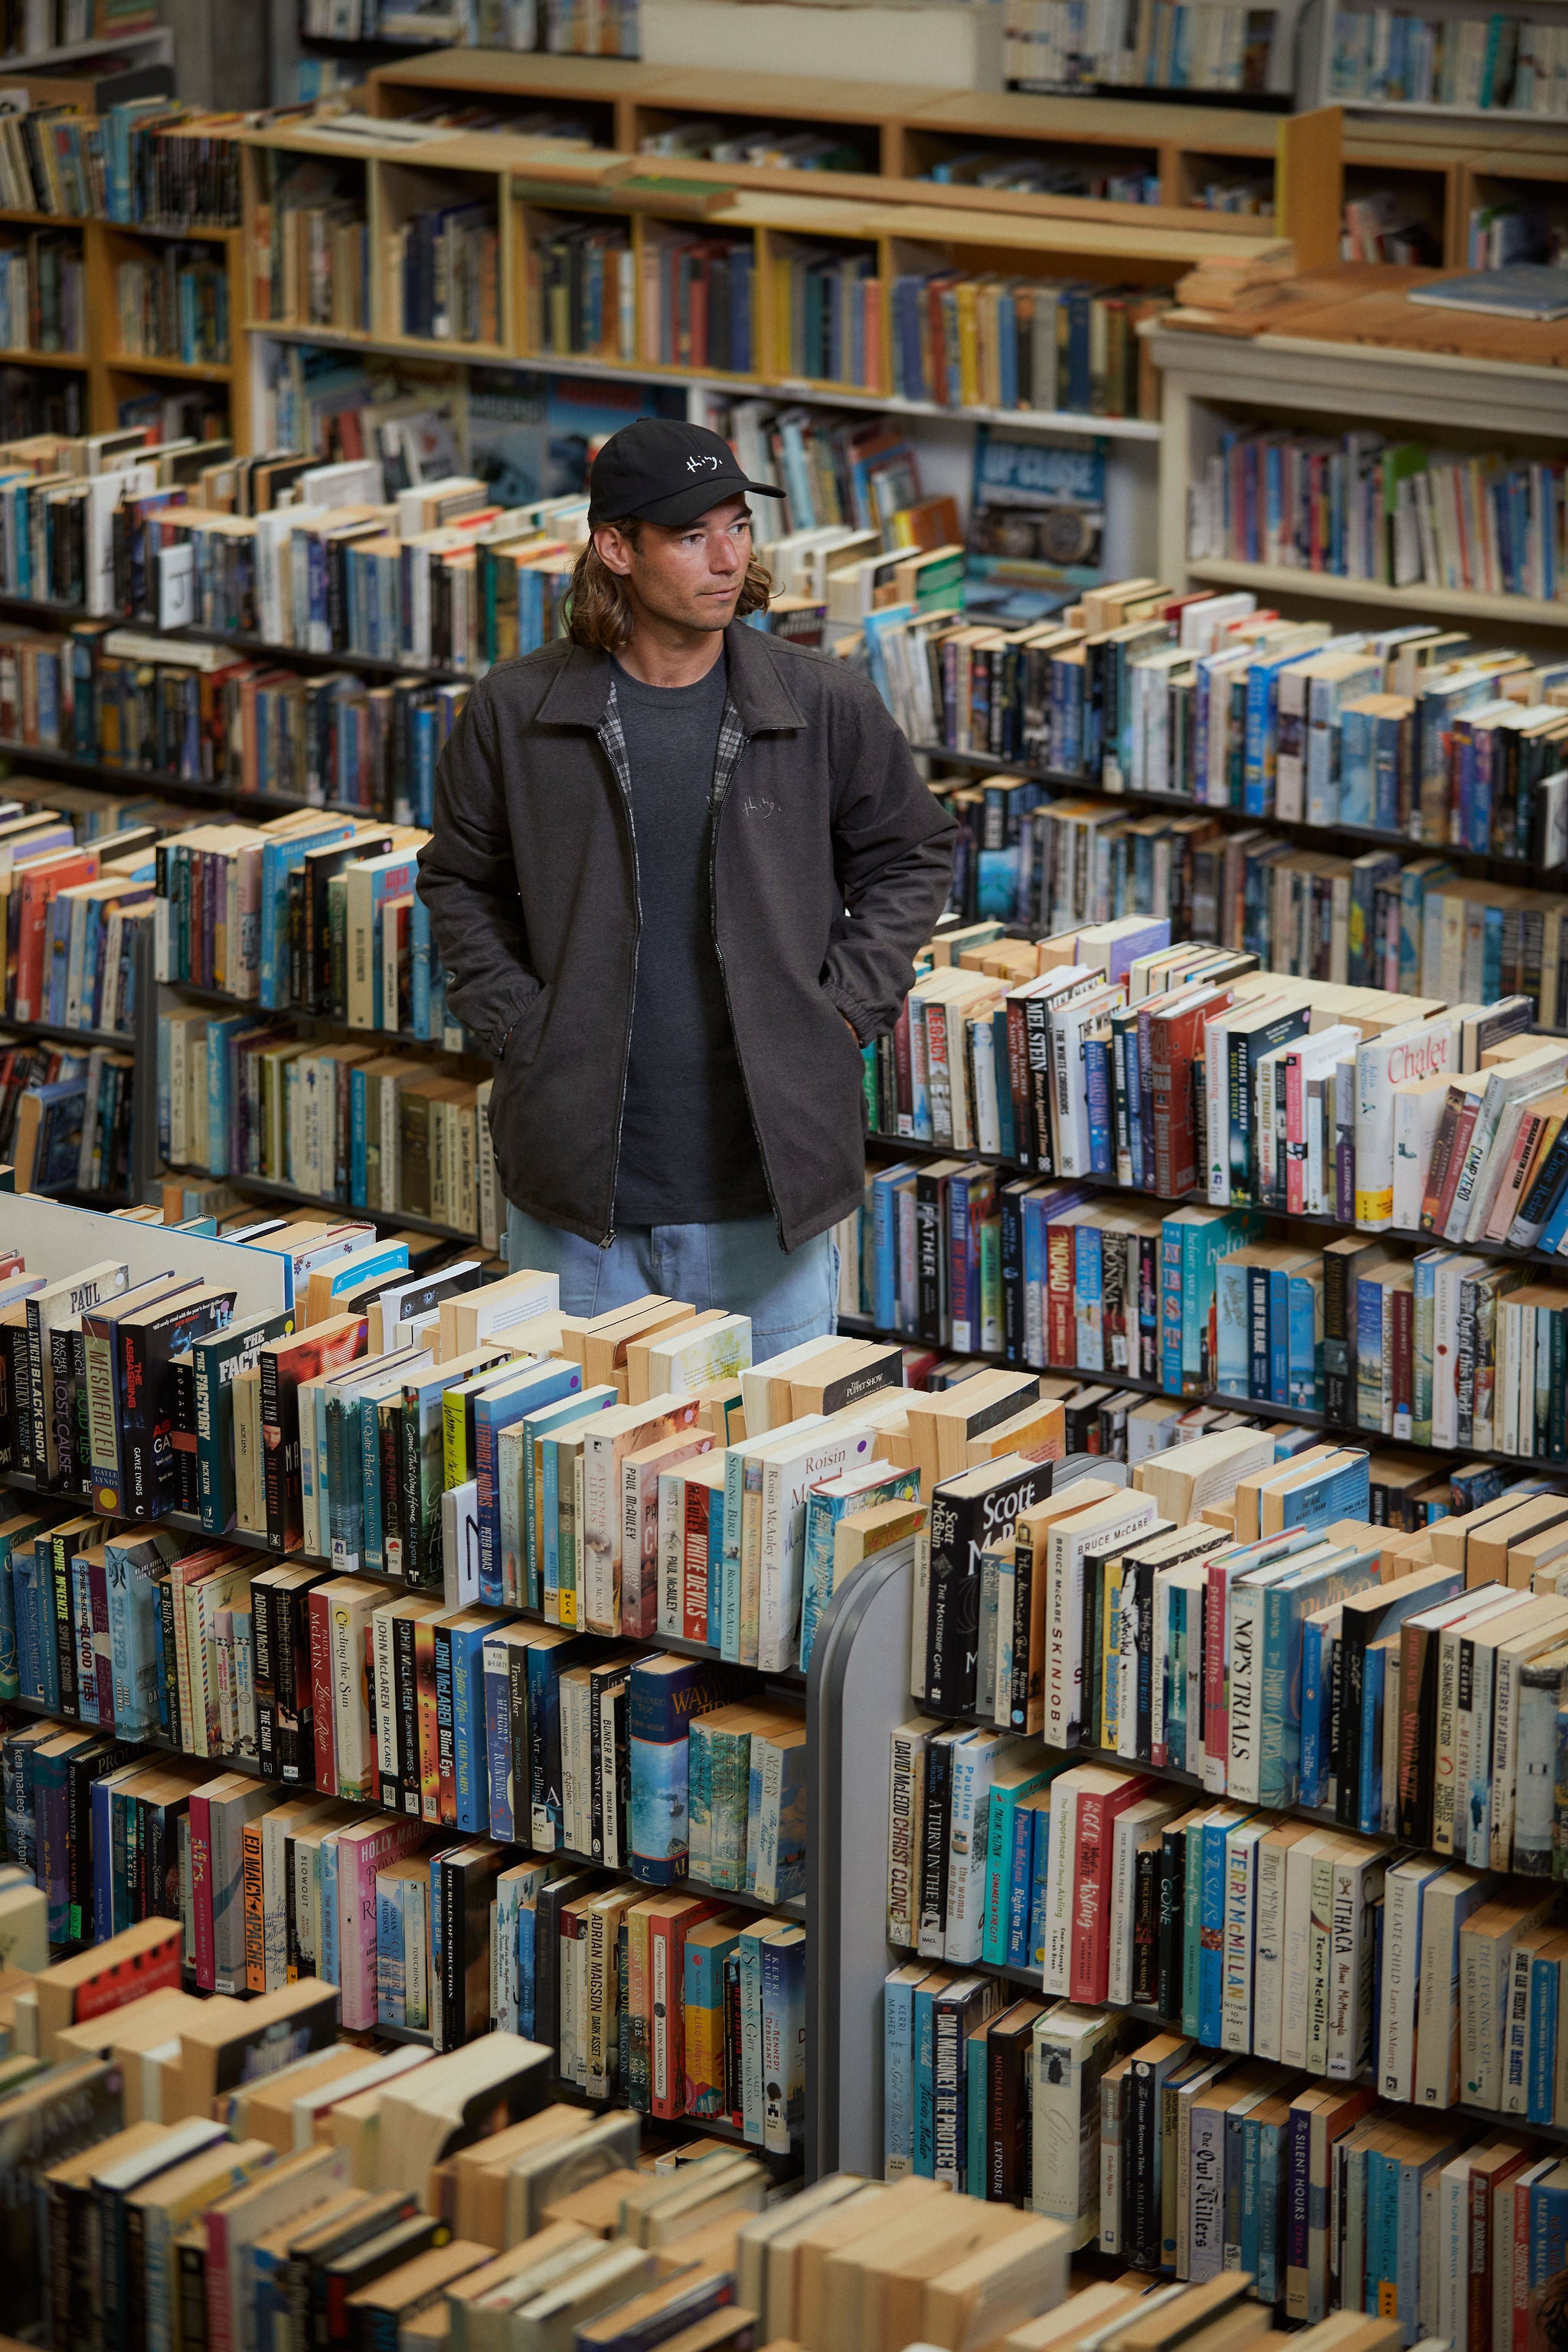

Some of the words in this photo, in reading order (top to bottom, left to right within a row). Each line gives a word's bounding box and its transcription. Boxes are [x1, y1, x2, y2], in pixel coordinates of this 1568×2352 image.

[1026, 1001, 1044, 1030] MEL
[926, 1008, 946, 1063] LEGACY
[1028, 1031, 1047, 1071] STEIN
[1055, 1030, 1065, 1043] THE
[1057, 1044, 1067, 1070] WHITE
[1238, 1042, 1247, 1083] PERSONS
[1387, 1036, 1448, 1086] Chalet
[1239, 1086, 1247, 1131] UNKNOWN
[1457, 1177, 1478, 1202] ZERO
[70, 1282, 101, 1314] PAUL
[243, 1330, 265, 1348] THE
[1458, 1314, 1474, 1338] Out
[197, 1351, 206, 1370] THE
[1459, 1339, 1474, 1353] of
[1459, 1354, 1474, 1377] this
[14, 1336, 30, 1408] ANNUNCIATION
[125, 1337, 136, 1408] ASSASSINS
[134, 1361, 142, 1387] THE
[846, 1380, 866, 1398] PUPPET
[865, 1373, 884, 1389] SHOW
[30, 1370, 44, 1417] BLACK
[54, 1380, 69, 1419] LOST
[90, 1351, 113, 1458] MESMERIZED
[197, 1373, 210, 1441] FACTORY
[1458, 1377, 1474, 1416] World
[34, 1419, 46, 1463] SNOW
[57, 1423, 72, 1474] CAUSE
[134, 1447, 143, 1472] GAYLE
[476, 1422, 492, 1468] TERRIBLE
[94, 1468, 118, 1478] GAYLE
[626, 1467, 636, 1491] PAUL
[729, 1455, 737, 1507] SINGING
[805, 1449, 846, 1475] Roisin
[95, 1476, 119, 1488] LYNDS
[135, 1472, 143, 1497] LYNDS
[477, 1471, 493, 1508] HOURS
[768, 1470, 778, 1506] Roisin
[625, 1494, 637, 1540] McAULEY
[728, 1509, 737, 1538] BIRD
[932, 1500, 947, 1548] McBain
[982, 1480, 1036, 1530] Scott
[481, 1526, 492, 1550] PETER
[766, 1509, 777, 1557] McAuley
[944, 1510, 958, 1546] Scott
[1077, 1534, 1110, 1556] BRUCE
[1113, 1519, 1149, 1540] McCABE
[52, 1537, 66, 1572] SOPHIE
[482, 1550, 493, 1572] MAAS
[667, 1556, 677, 1573] PAUL
[687, 1531, 707, 1573] WHITE
[54, 1575, 69, 1621] McKENZIE
[253, 1592, 267, 1632] ADRIAN
[666, 1576, 678, 1612] McAULEY
[687, 1574, 707, 1619] DEVILS
[1054, 1579, 1062, 1623] McCABE
[311, 1612, 322, 1670] McLAIN
[376, 1619, 388, 1646] JOHN
[398, 1621, 411, 1647] JOHN
[936, 1602, 946, 1651] MASTERSHIP
[80, 1626, 93, 1670] BLOOD
[256, 1633, 270, 1678] McKINTY
[435, 1638, 449, 1668] JOHN
[934, 1653, 943, 1680] GAME
[83, 1673, 95, 1703] TIES
[377, 1648, 390, 1710] McLAREN
[399, 1649, 413, 1711] McLAREN
[511, 1663, 521, 1717] Traveller
[1050, 1628, 1063, 1723] SKINJOB
[436, 1668, 452, 1728] McLAREN
[260, 1710, 270, 1726] THE
[382, 1716, 390, 1745] BLACK
[405, 1714, 413, 1749] RUNNING
[603, 1720, 612, 1752] BUNKER
[261, 1726, 272, 1752] CHAIN
[383, 1746, 392, 1769] CABS
[440, 1729, 453, 1756] Blind
[894, 1740, 911, 1771] DAVID
[406, 1751, 414, 1773] RINGS
[441, 1758, 453, 1779] Eye
[494, 1753, 507, 1801] RUNNING
[604, 1754, 612, 1775] MAN
[893, 1772, 910, 1817] McLEOD
[962, 1766, 975, 1821] Pauline
[244, 1834, 260, 1852] ED
[361, 1839, 391, 1864] HOLLY
[891, 1818, 909, 1865] CHRIST
[246, 1854, 262, 1902] MACY
[301, 1855, 309, 1909] BLOWOUT
[890, 1867, 908, 1919] CLONE
[1230, 1849, 1248, 1906] TERRY
[389, 1905, 397, 1931] SUSAN
[1160, 1878, 1172, 1924] GONE
[247, 1910, 263, 1971] APACHE
[447, 1919, 453, 1929] OF
[592, 1913, 603, 1957] ADRIAN
[1334, 1899, 1354, 1955] ITHACA
[1227, 1909, 1246, 2001] McMILLAN
[1315, 1936, 1325, 1975] Terry
[591, 1958, 603, 2013] MAGSON
[592, 2015, 601, 2035] DARK
[887, 1998, 896, 2036] MAHER
[1312, 1978, 1325, 2042] McMillan
[591, 2036, 601, 2058] ASSET
[745, 2057, 754, 2114] MAGNUSSON
[1201, 2130, 1211, 2149] The
[1296, 2135, 1307, 2176] SILENT
[993, 2141, 1003, 2197] EXPOSURE
[1197, 2150, 1215, 2183] Owl
[1194, 2185, 1216, 2248] Killers
[1295, 2180, 1306, 2223] HOURS
[1512, 2242, 1529, 2310] SURRENDER
